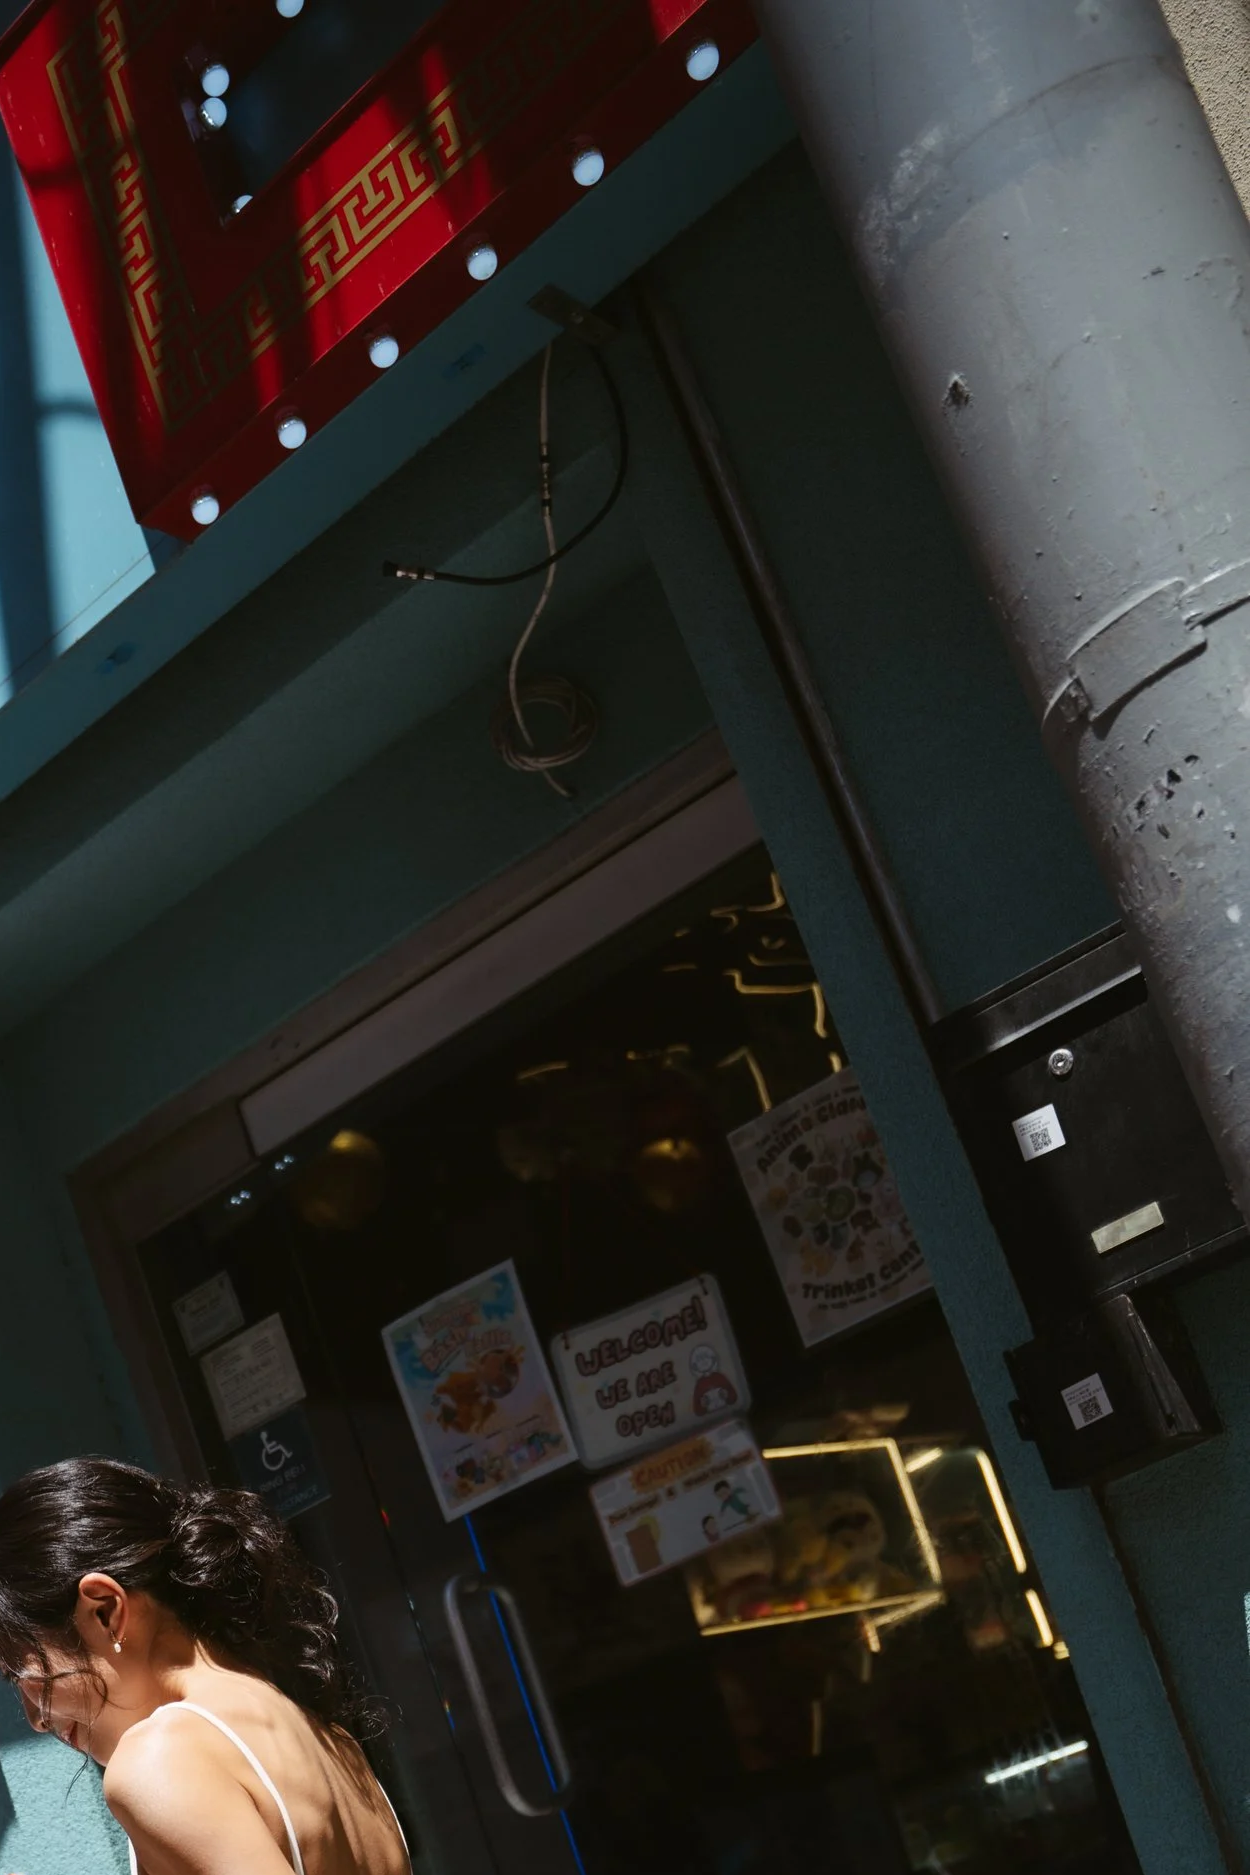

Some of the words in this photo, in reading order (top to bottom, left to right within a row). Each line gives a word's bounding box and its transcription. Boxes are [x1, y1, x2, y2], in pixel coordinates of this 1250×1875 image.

[576, 1295, 708, 1377] WELCOME!
[596, 1378, 632, 1411] WE
[635, 1363, 676, 1399] ARE
[616, 1401, 676, 1438] OPEN
[634, 1447, 705, 1485] CAUTION
